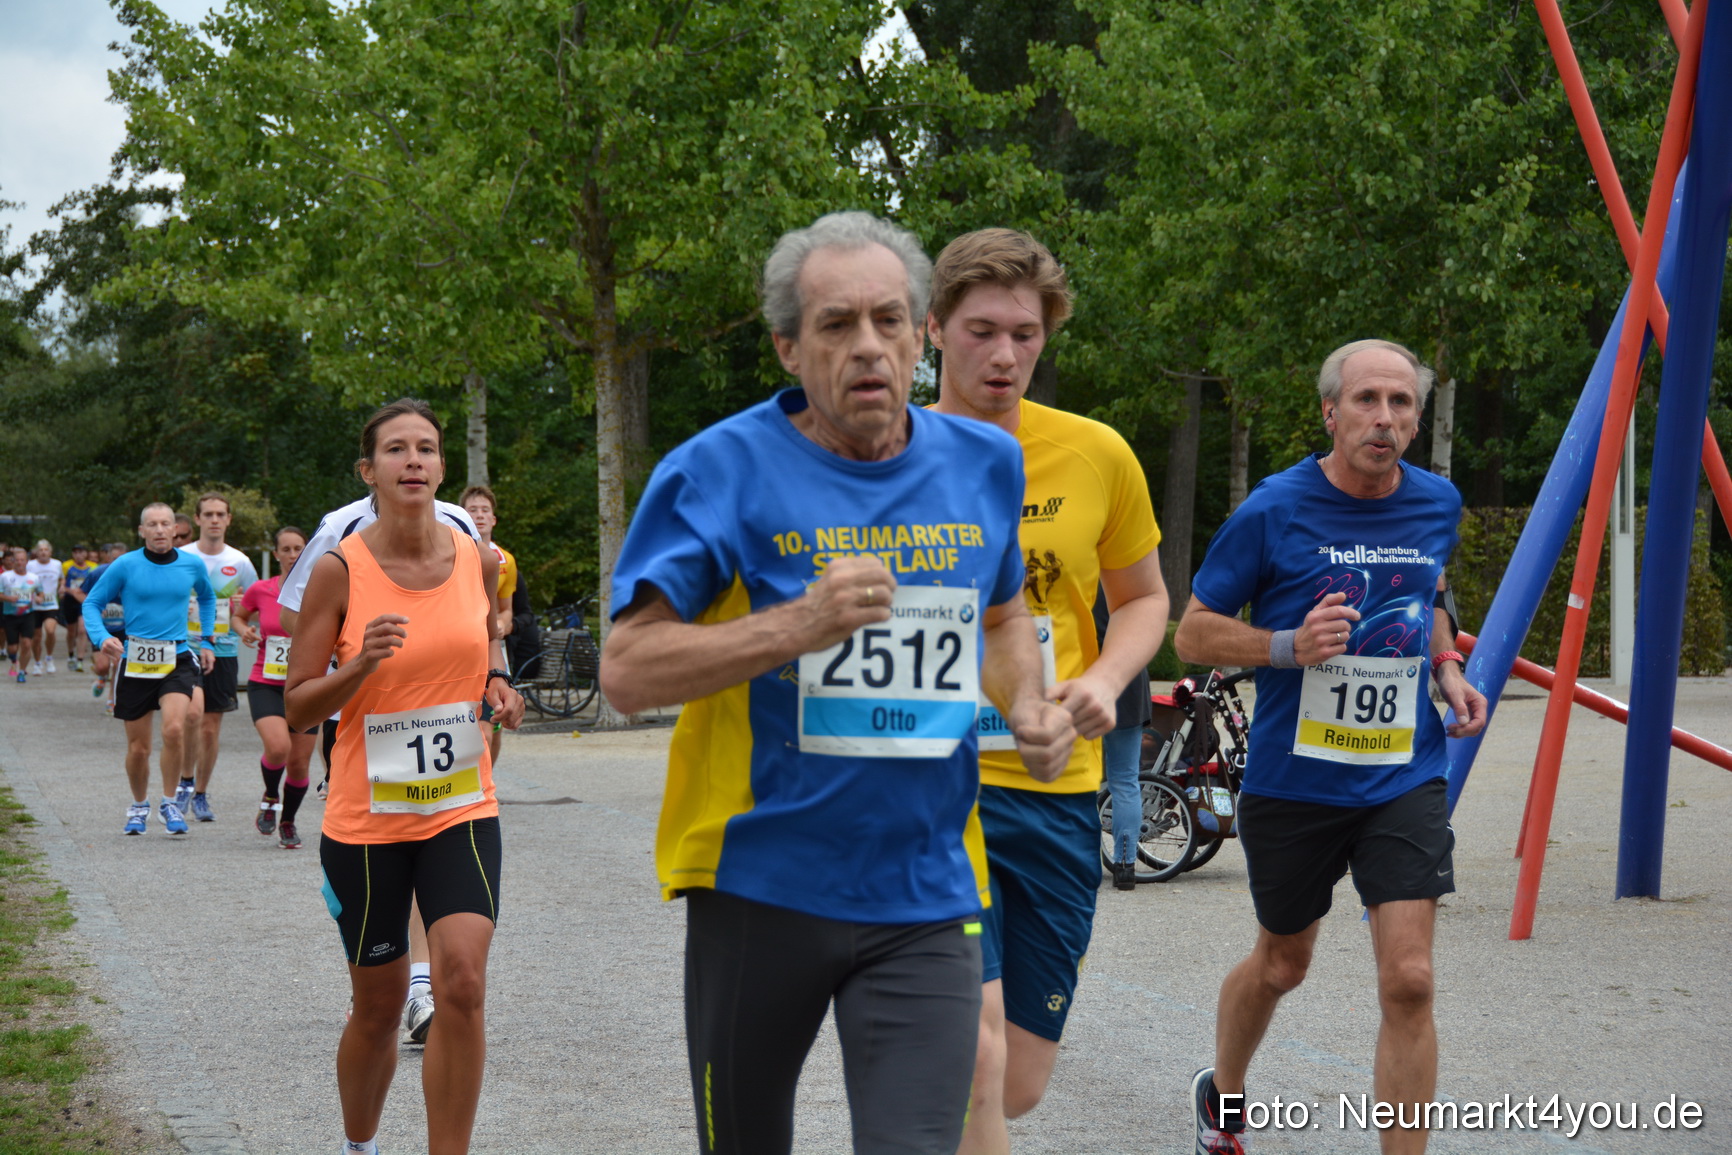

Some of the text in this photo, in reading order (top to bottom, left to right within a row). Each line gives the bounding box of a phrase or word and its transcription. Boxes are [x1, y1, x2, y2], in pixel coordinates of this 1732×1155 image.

[772, 524, 984, 556] 10. NEUMARKTER
[1330, 545, 1377, 564] hella
[1378, 546, 1418, 557] hamburg
[889, 606, 954, 620] eumarkt
[137, 646, 164, 662] 281
[822, 628, 962, 691] 2512
[1308, 664, 1403, 679] PARTL Neumarkt
[1330, 682, 1398, 724] 198
[368, 714, 466, 735] PARTL Neumarkt
[872, 707, 916, 731] Otto
[1324, 729, 1391, 750] Reinhold
[406, 732, 454, 774] 13
[406, 782, 452, 800] Milena
[1047, 994, 1063, 1012] 3
